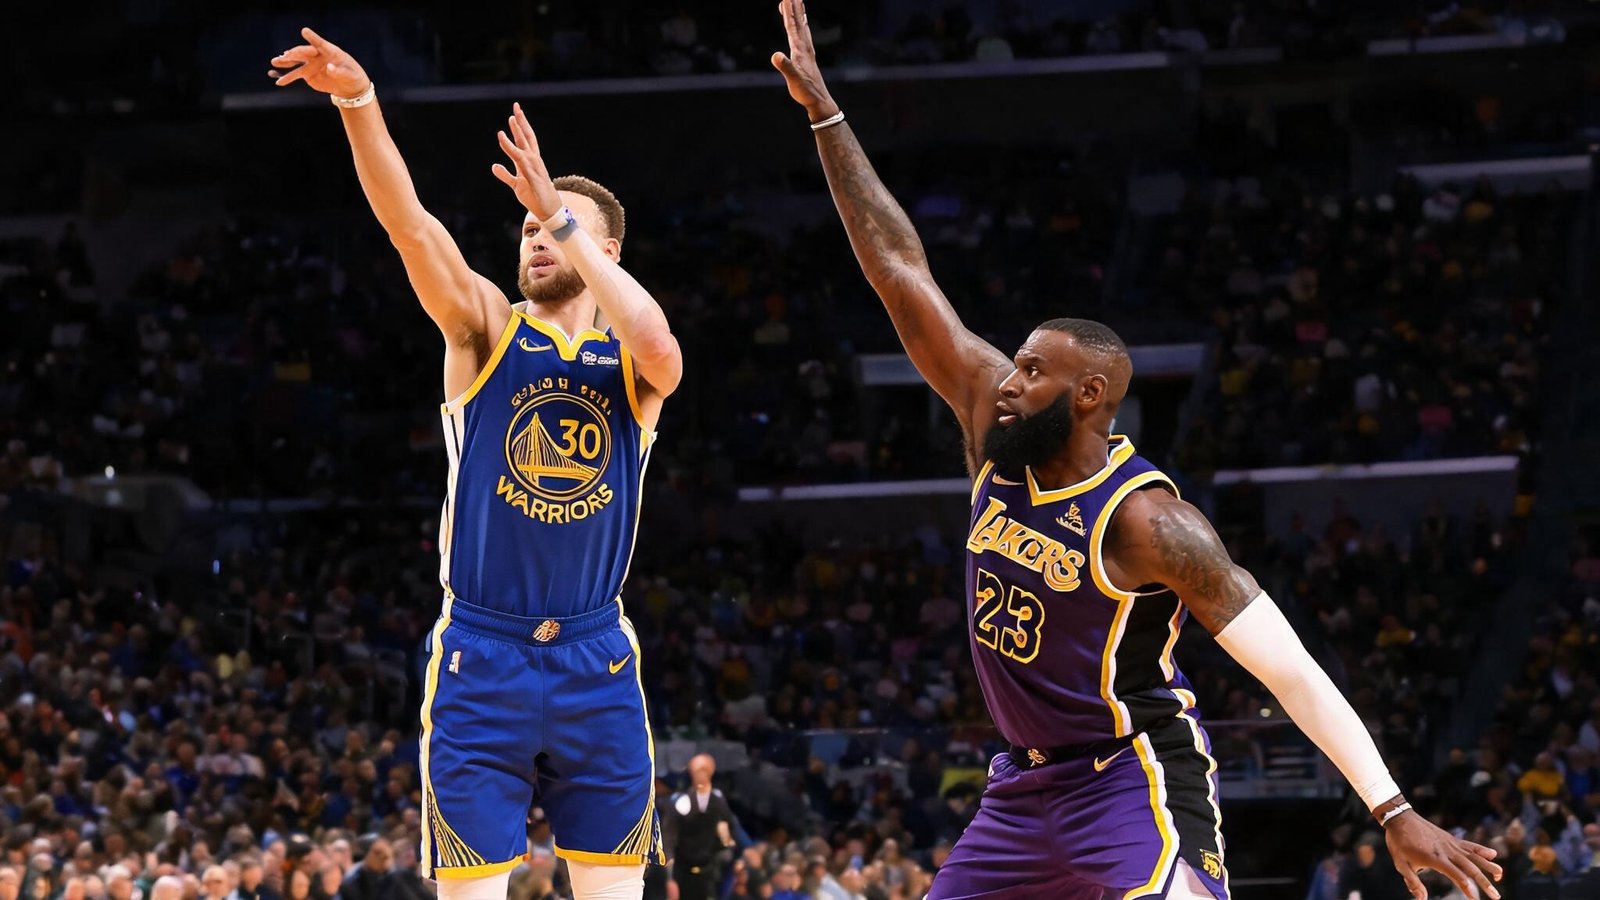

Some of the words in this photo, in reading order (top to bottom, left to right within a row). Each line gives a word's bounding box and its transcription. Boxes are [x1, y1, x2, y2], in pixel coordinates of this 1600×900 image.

[560, 419, 601, 460] 30
[496, 475, 614, 523] WARRIORS
[974, 568, 1045, 663] 23
